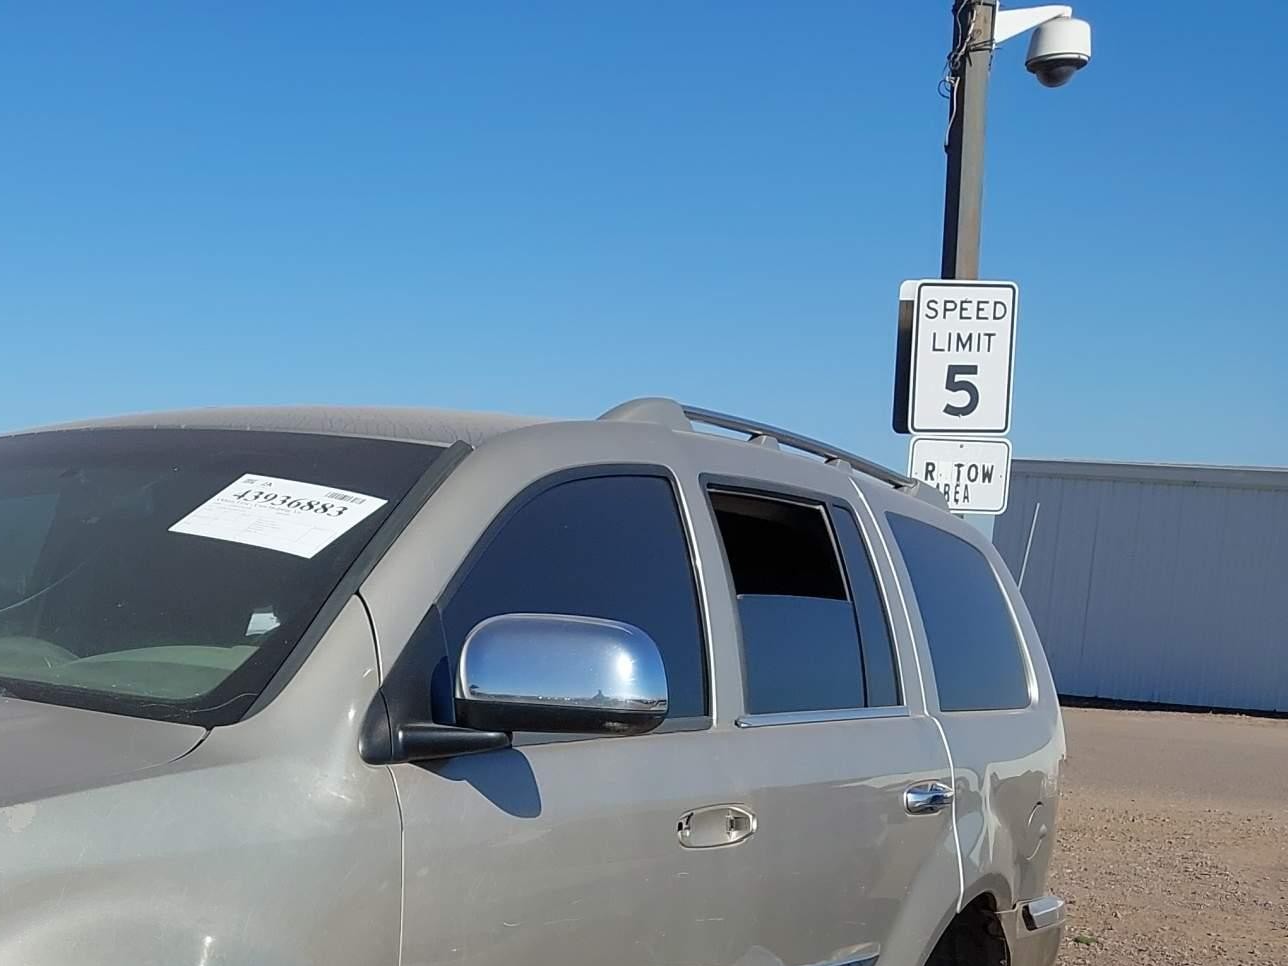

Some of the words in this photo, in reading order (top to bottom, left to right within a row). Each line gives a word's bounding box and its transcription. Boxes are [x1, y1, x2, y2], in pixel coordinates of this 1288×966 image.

[925, 300, 1007, 320] SPEED
[932, 332, 996, 352] LIMIT
[942, 364, 979, 417] 5
[954, 462, 994, 483] TOW
[233, 489, 349, 517] 43936883
